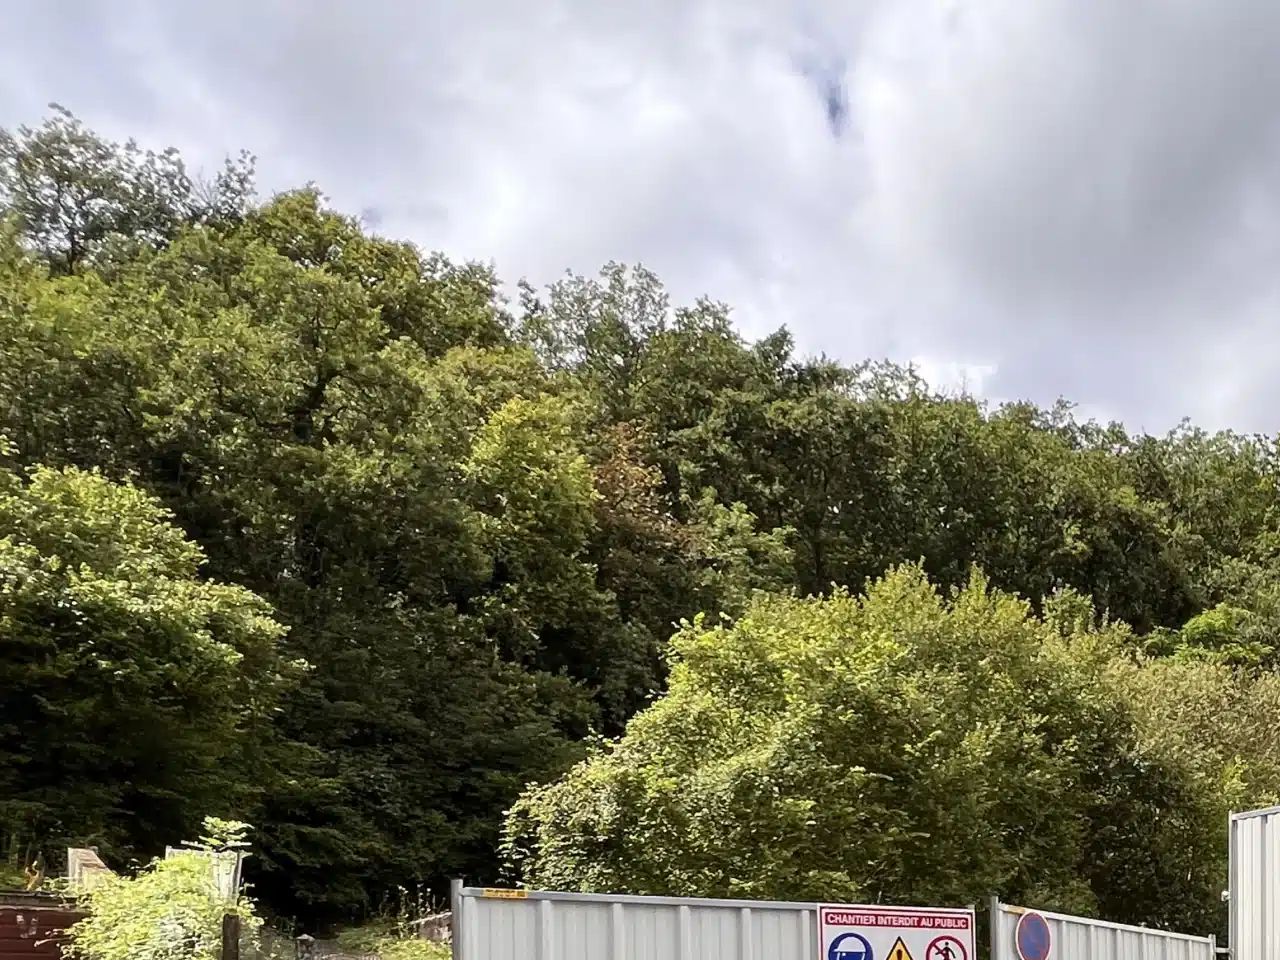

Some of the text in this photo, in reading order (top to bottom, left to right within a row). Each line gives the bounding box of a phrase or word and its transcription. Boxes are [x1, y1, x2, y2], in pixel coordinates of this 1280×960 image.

[827, 913, 967, 928] CHANTIER INTERDIT AU PUBLIC
